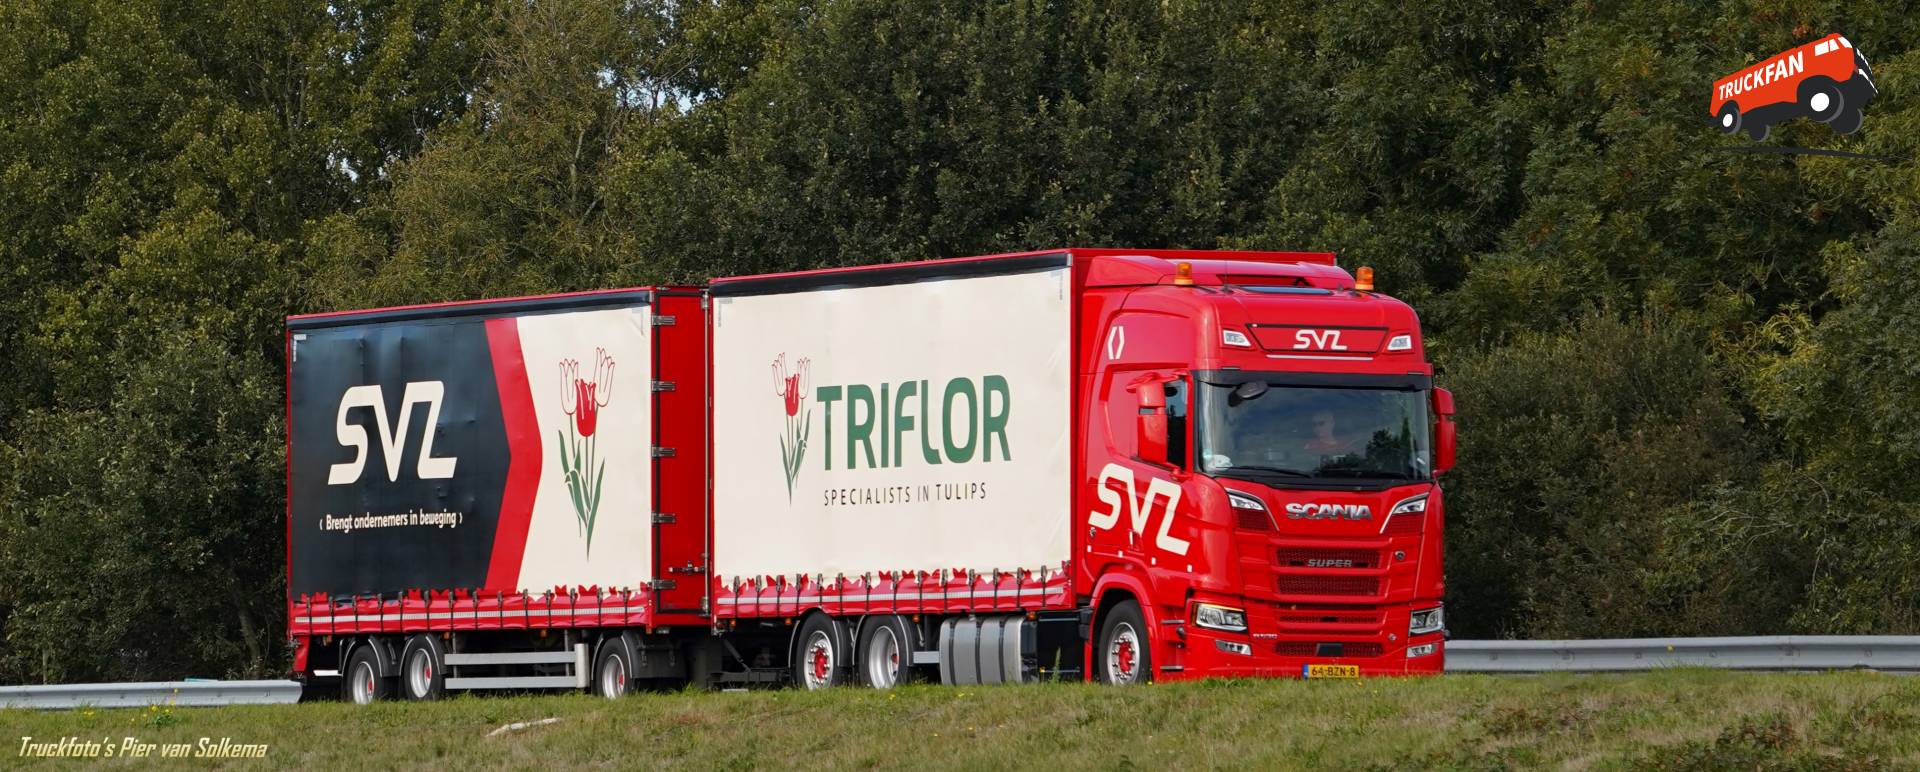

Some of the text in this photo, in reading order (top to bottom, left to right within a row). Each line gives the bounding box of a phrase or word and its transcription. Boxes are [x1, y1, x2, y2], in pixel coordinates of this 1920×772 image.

[1293, 329, 1348, 350] SVZ
[328, 380, 458, 485] SVZ
[816, 374, 1012, 471] TRIFLOR
[824, 482, 986, 506] SPECIALISTS IN TULIPS
[326, 508, 457, 533] Brengt ondernemers in beweging
[1088, 462, 1191, 556] SVZ
[1285, 503, 1373, 520] SCANIA
[1307, 559, 1352, 567] SUPER
[1311, 666, 1356, 677] 64-BZN-8
